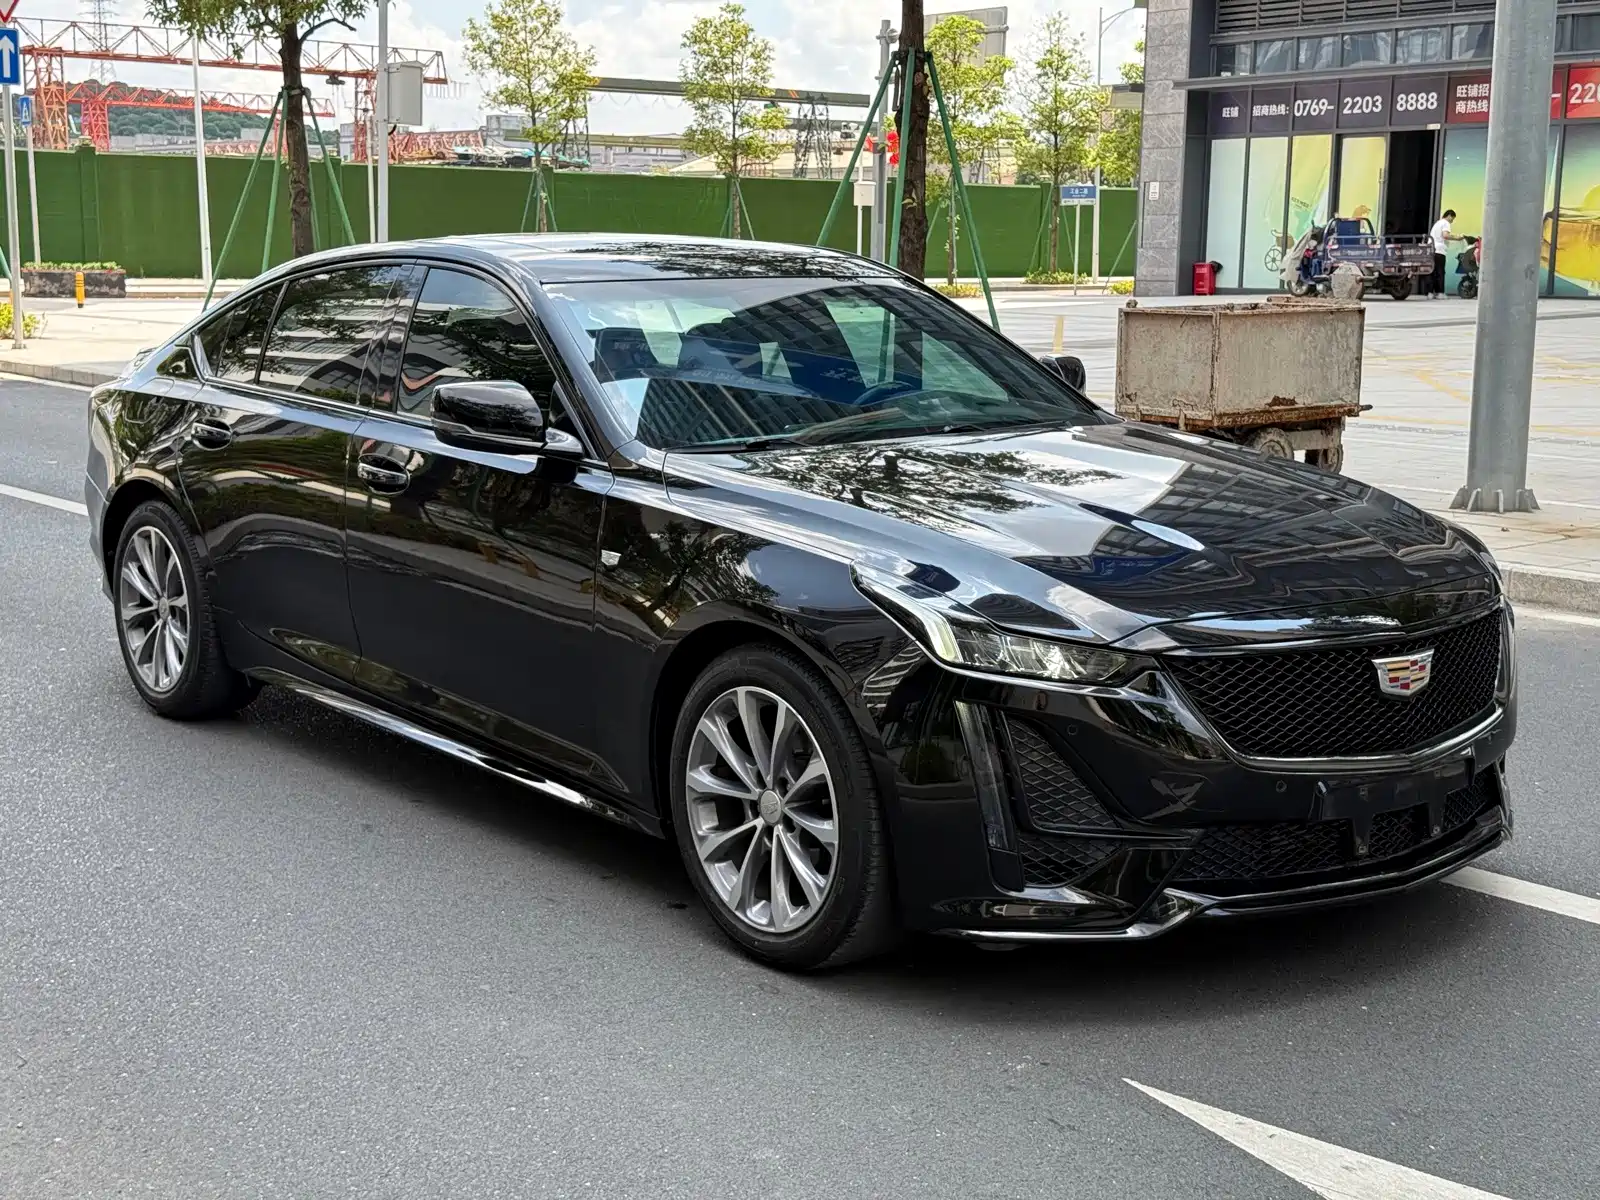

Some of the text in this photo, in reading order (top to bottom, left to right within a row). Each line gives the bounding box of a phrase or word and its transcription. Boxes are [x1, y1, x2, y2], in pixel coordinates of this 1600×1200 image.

[1456, 83, 1490, 98] 旺铺招
[1569, 82, 1600, 104] 22
[1222, 106, 1239, 118] 旺铺
[1294, 98, 1335, 117] 0769-
[1342, 95, 1382, 115] 2203
[1396, 91, 1438, 112] 8888
[1455, 99, 1489, 115] 商热线
